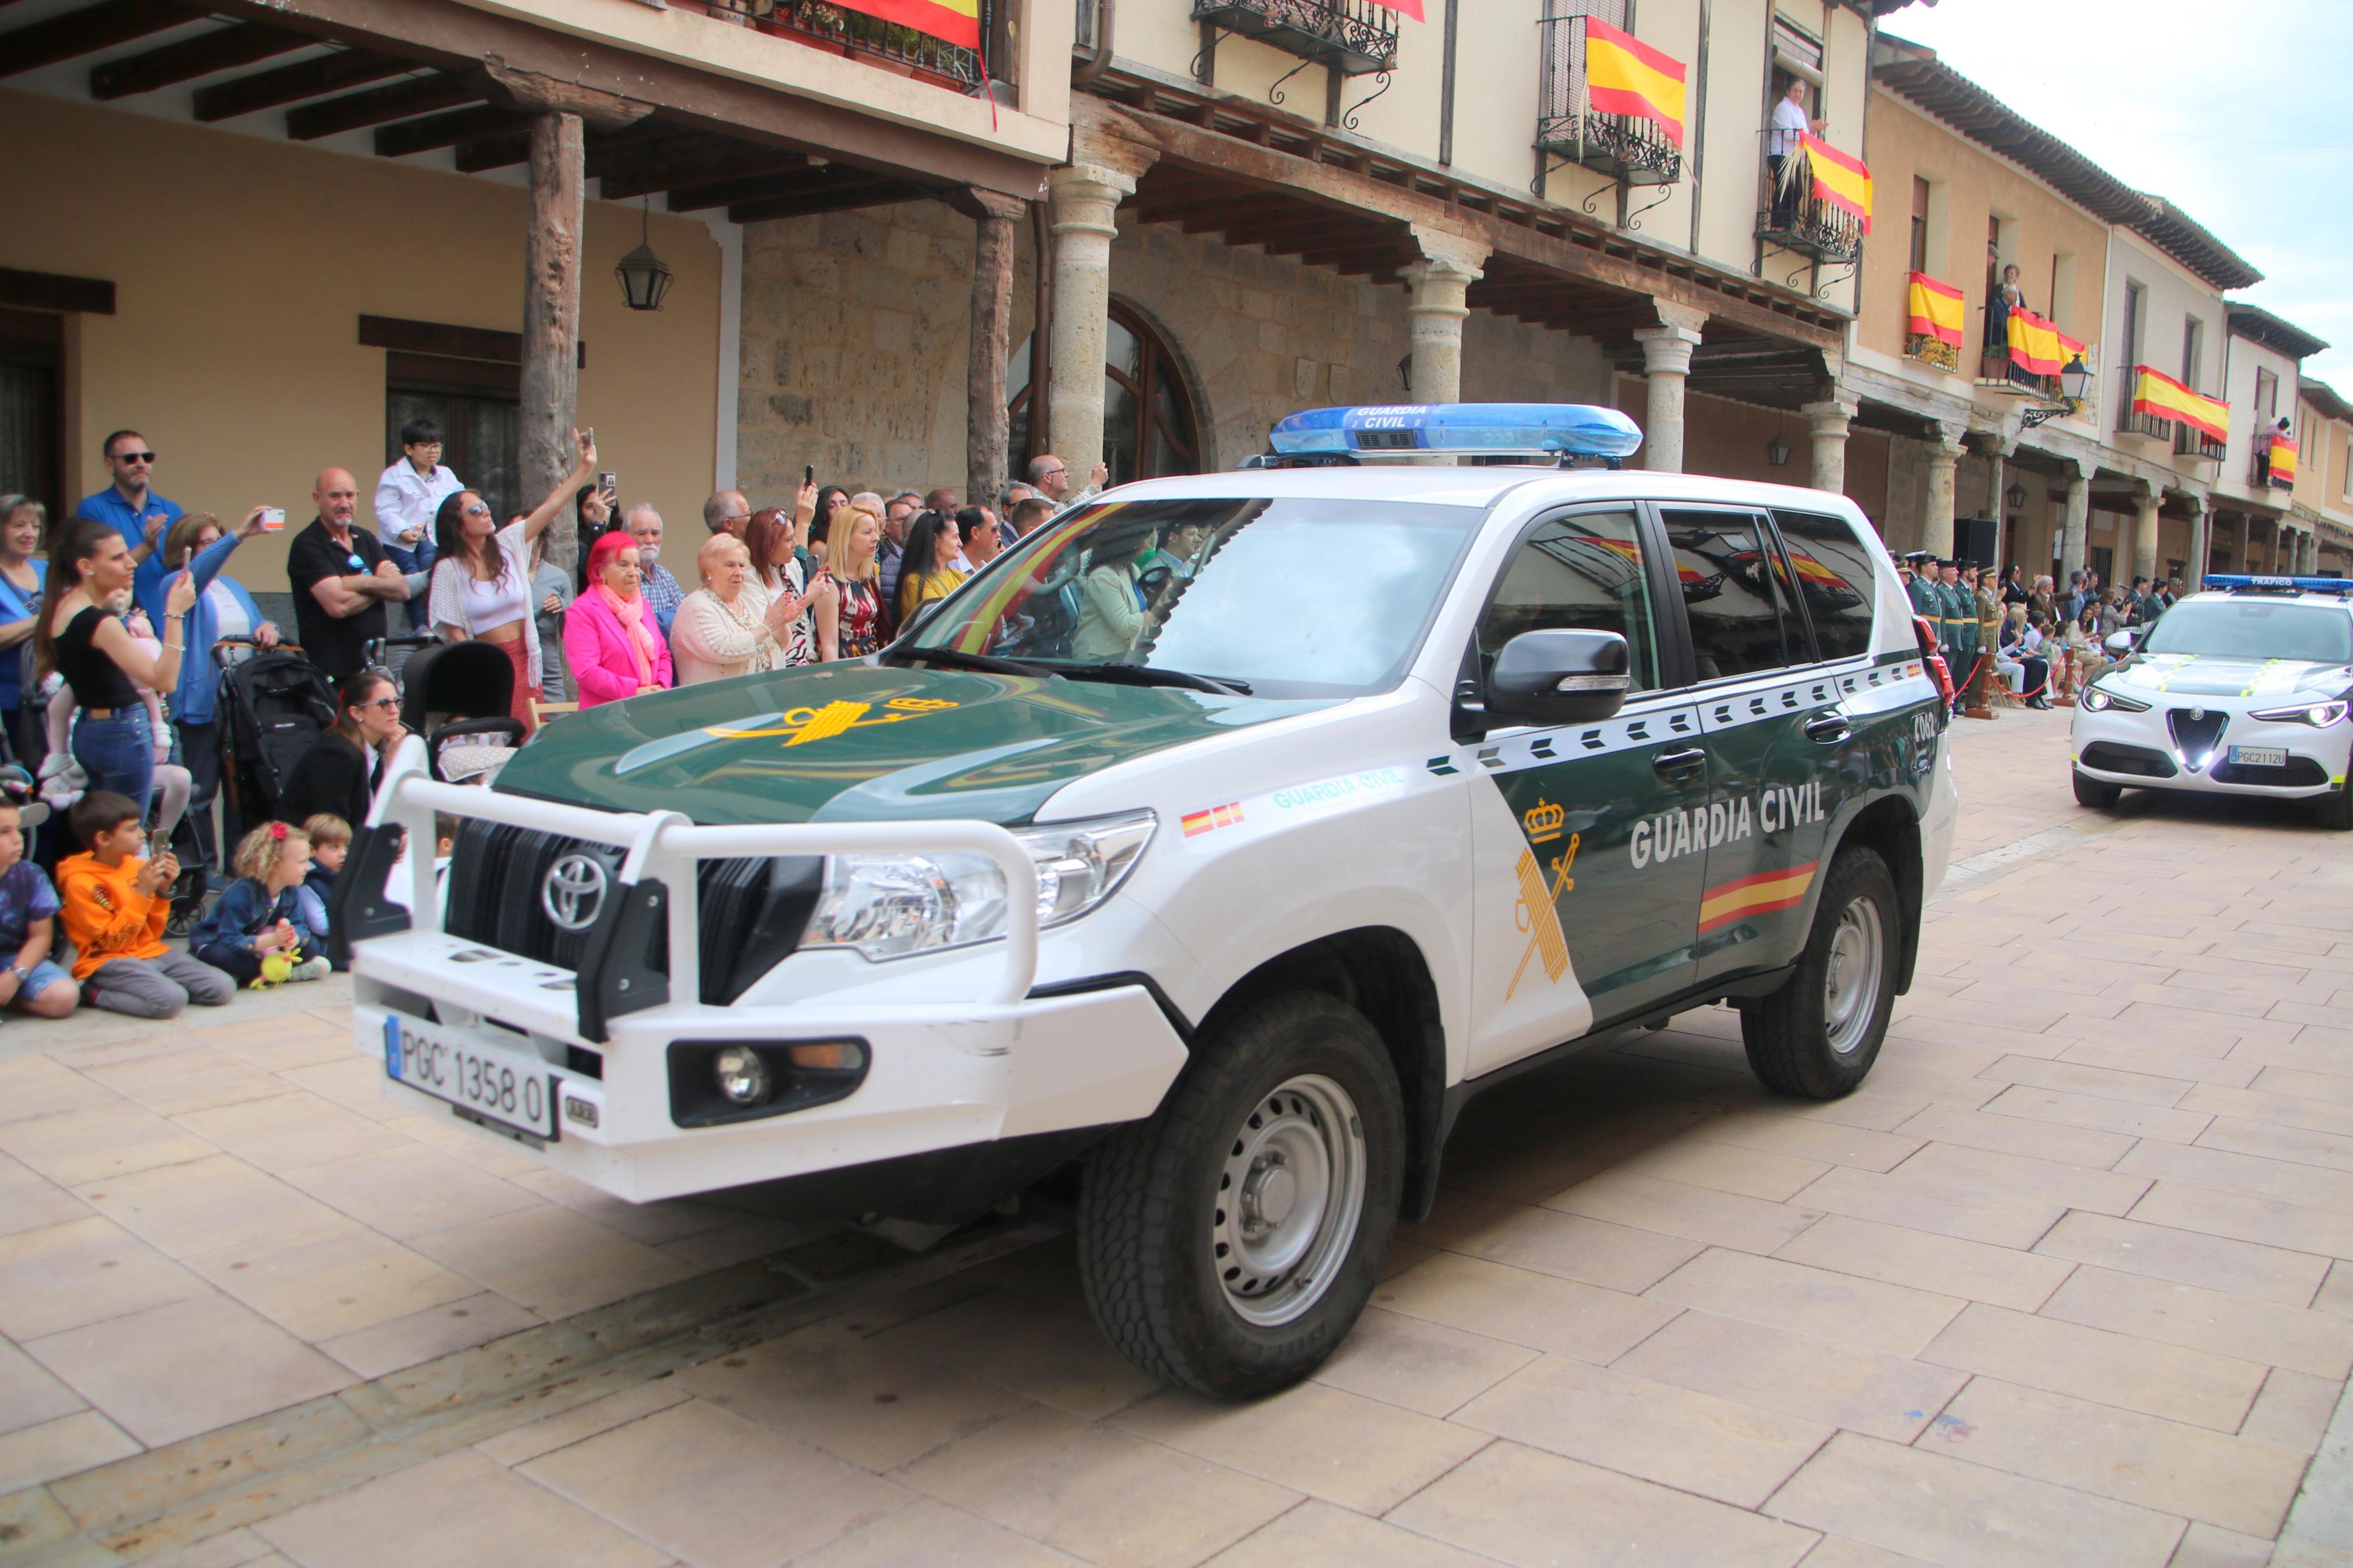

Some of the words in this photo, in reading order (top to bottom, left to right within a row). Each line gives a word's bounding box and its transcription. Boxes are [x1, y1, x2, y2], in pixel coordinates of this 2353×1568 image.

[1357, 406, 1427, 416] GUARDIA
[1364, 417, 1406, 428] CIVIL
[1273, 778, 1361, 809] GUARDIA
[1357, 768, 1405, 790] CIVIL
[1630, 796, 1751, 869] GUARDIA
[1760, 781, 1825, 833] CIVIL
[402, 1030, 445, 1086] PGC
[456, 1051, 516, 1114] 1358
